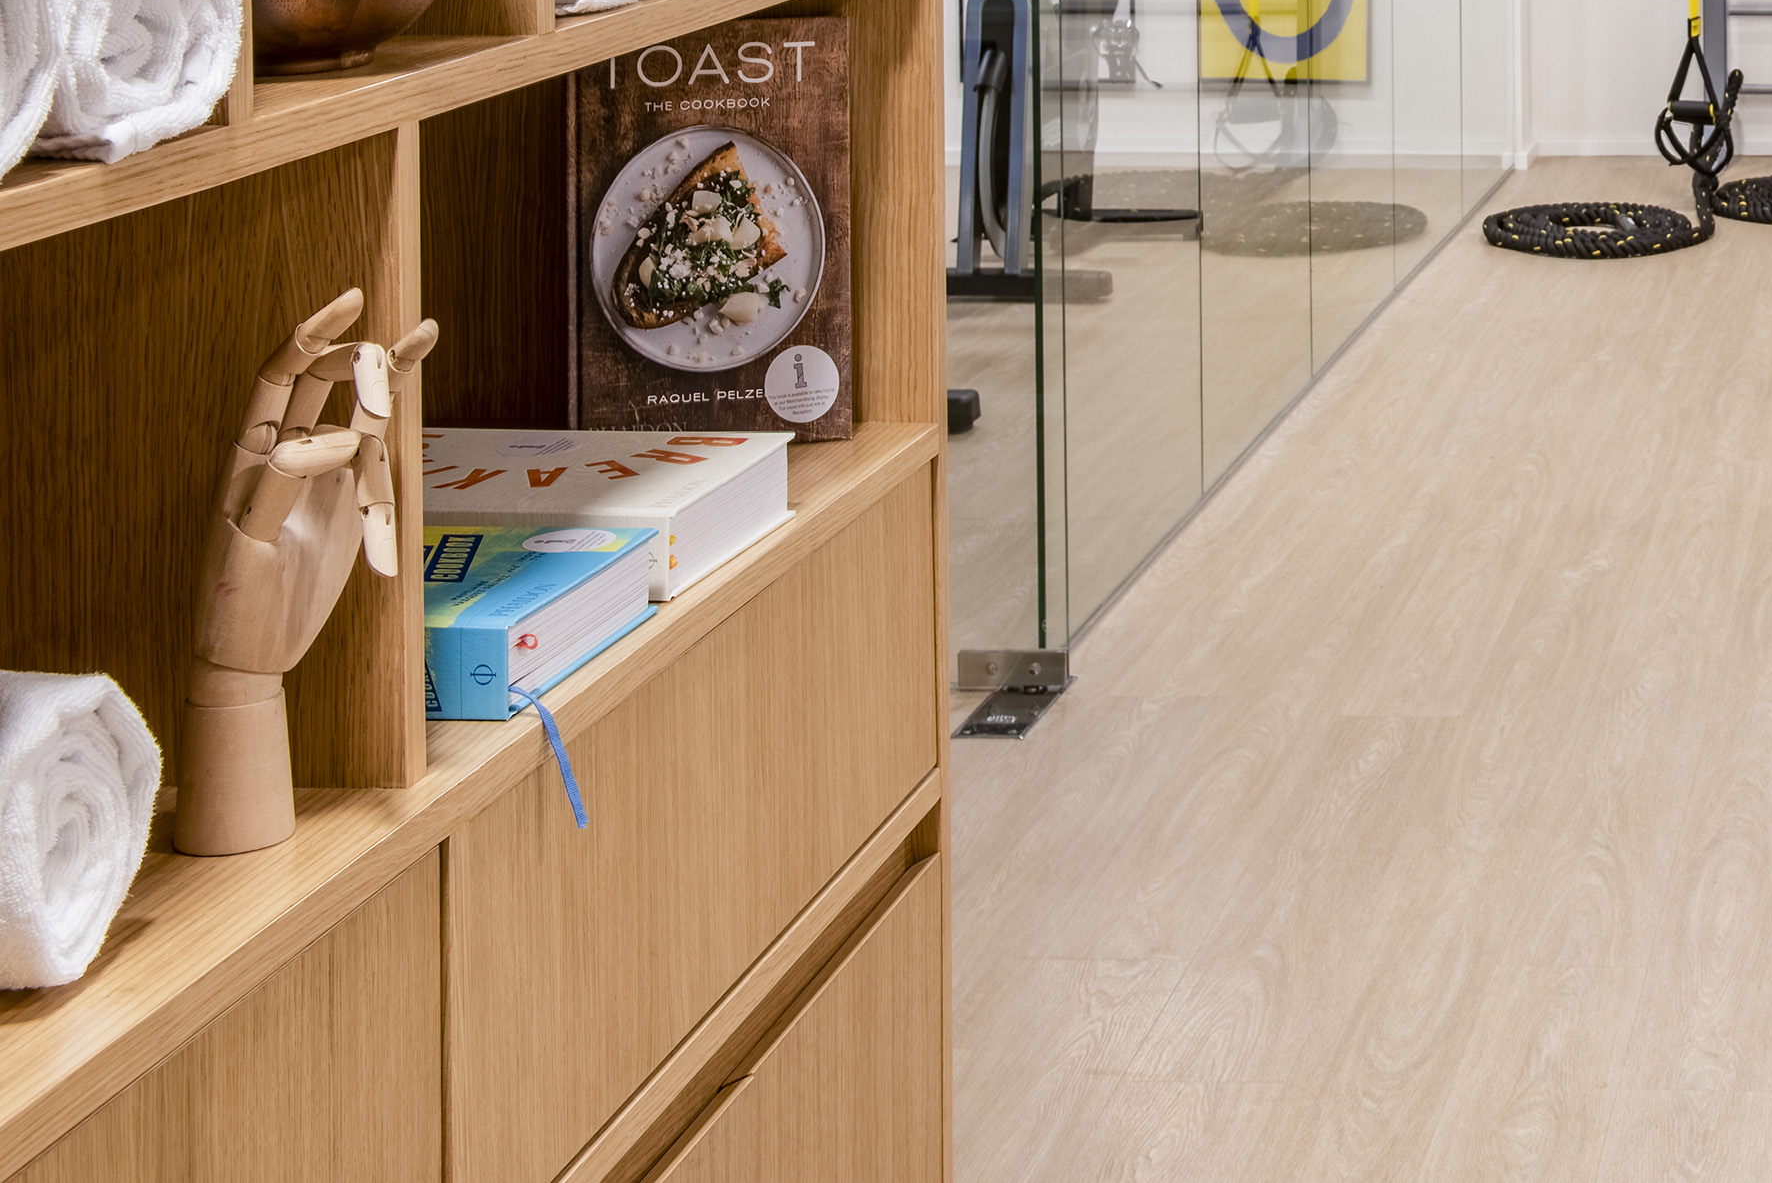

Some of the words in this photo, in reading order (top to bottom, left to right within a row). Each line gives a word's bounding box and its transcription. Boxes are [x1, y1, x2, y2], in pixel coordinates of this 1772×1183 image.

[644, 100, 673, 112] THE
[679, 97, 771, 111] COOKBOOK
[647, 392, 710, 405] RAQUEL
[716, 388, 766, 400] PELZE
[430, 536, 476, 580] COOKBOOK
